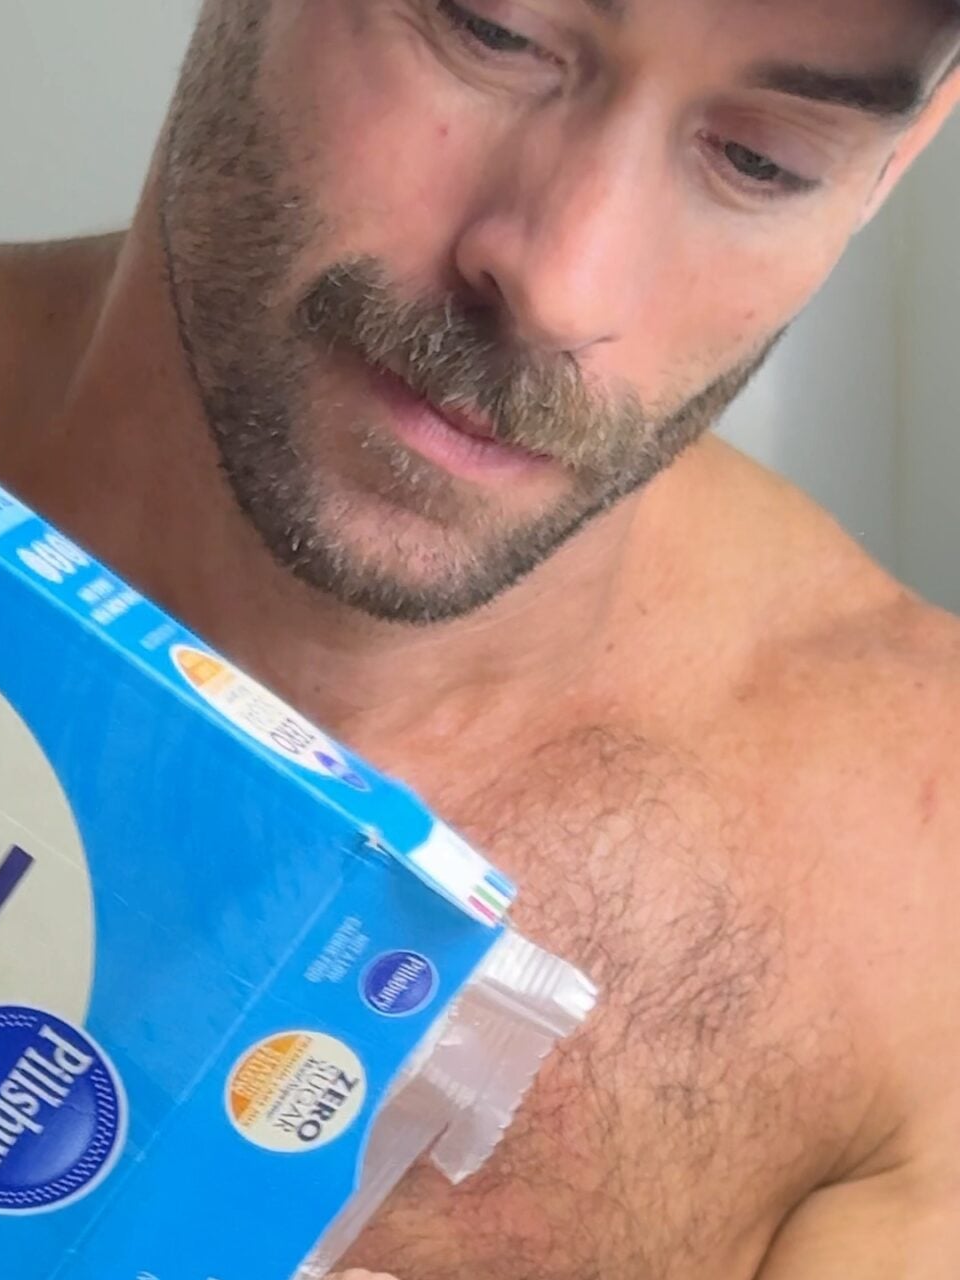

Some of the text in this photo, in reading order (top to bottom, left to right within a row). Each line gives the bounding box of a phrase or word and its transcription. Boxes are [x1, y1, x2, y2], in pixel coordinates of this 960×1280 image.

[369, 956, 427, 1012] Pillsbury
[272, 1060, 338, 1134] SUGAR
[298, 1071, 360, 1145] ZERO
